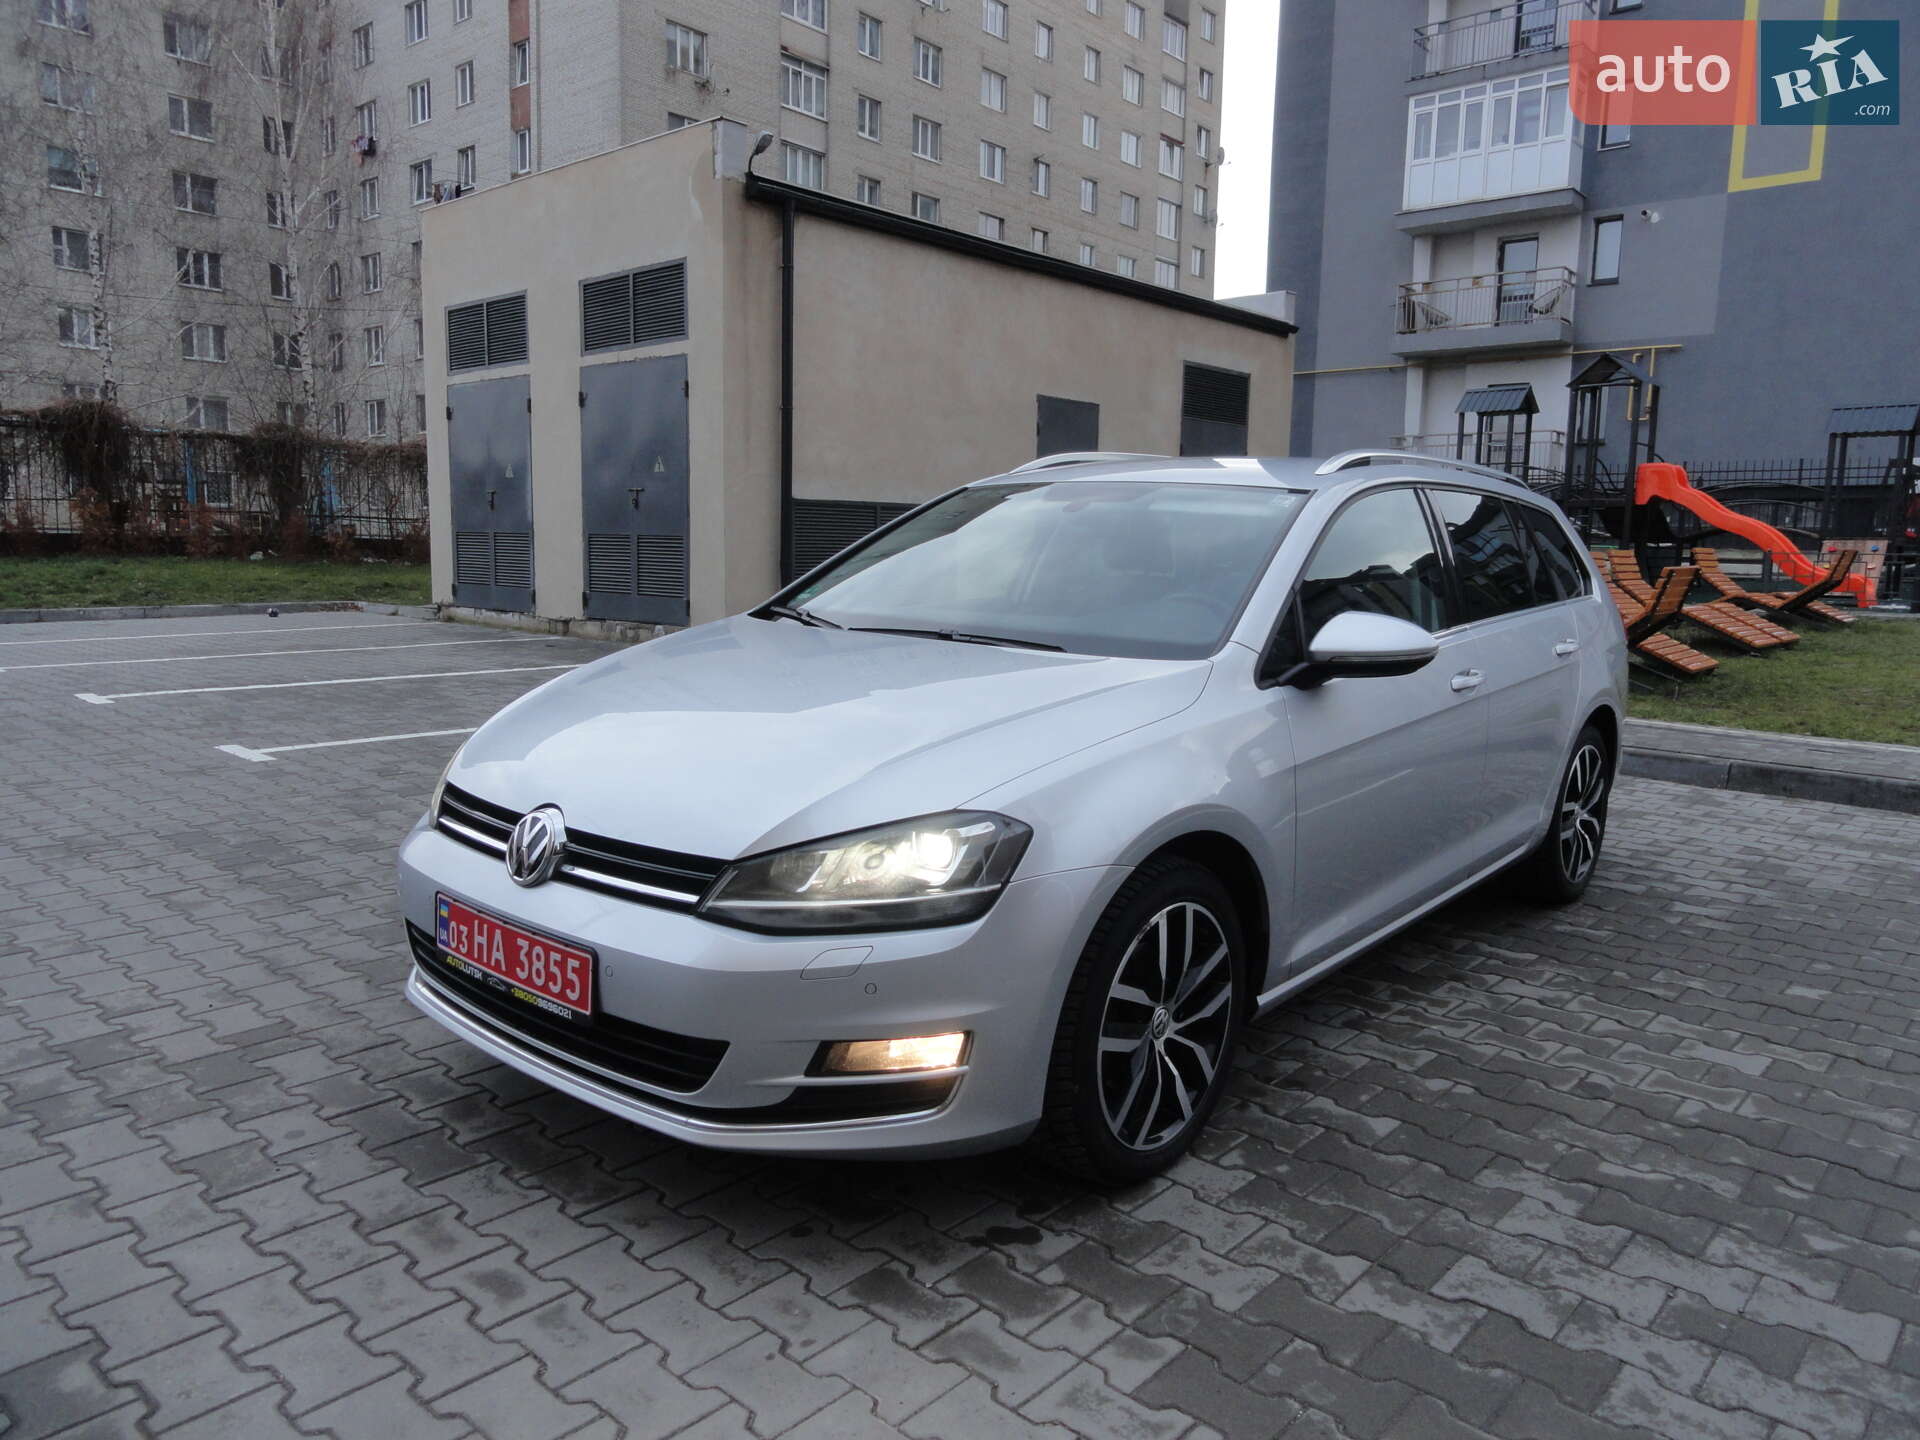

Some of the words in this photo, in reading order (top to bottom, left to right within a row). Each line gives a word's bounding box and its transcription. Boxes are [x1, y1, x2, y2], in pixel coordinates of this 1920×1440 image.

[439, 927, 449, 943] UA
[446, 955, 484, 981] AUTOLUTSK
[449, 920, 469, 954] 03
[473, 919, 507, 972] HA
[515, 937, 581, 1001] 3855
